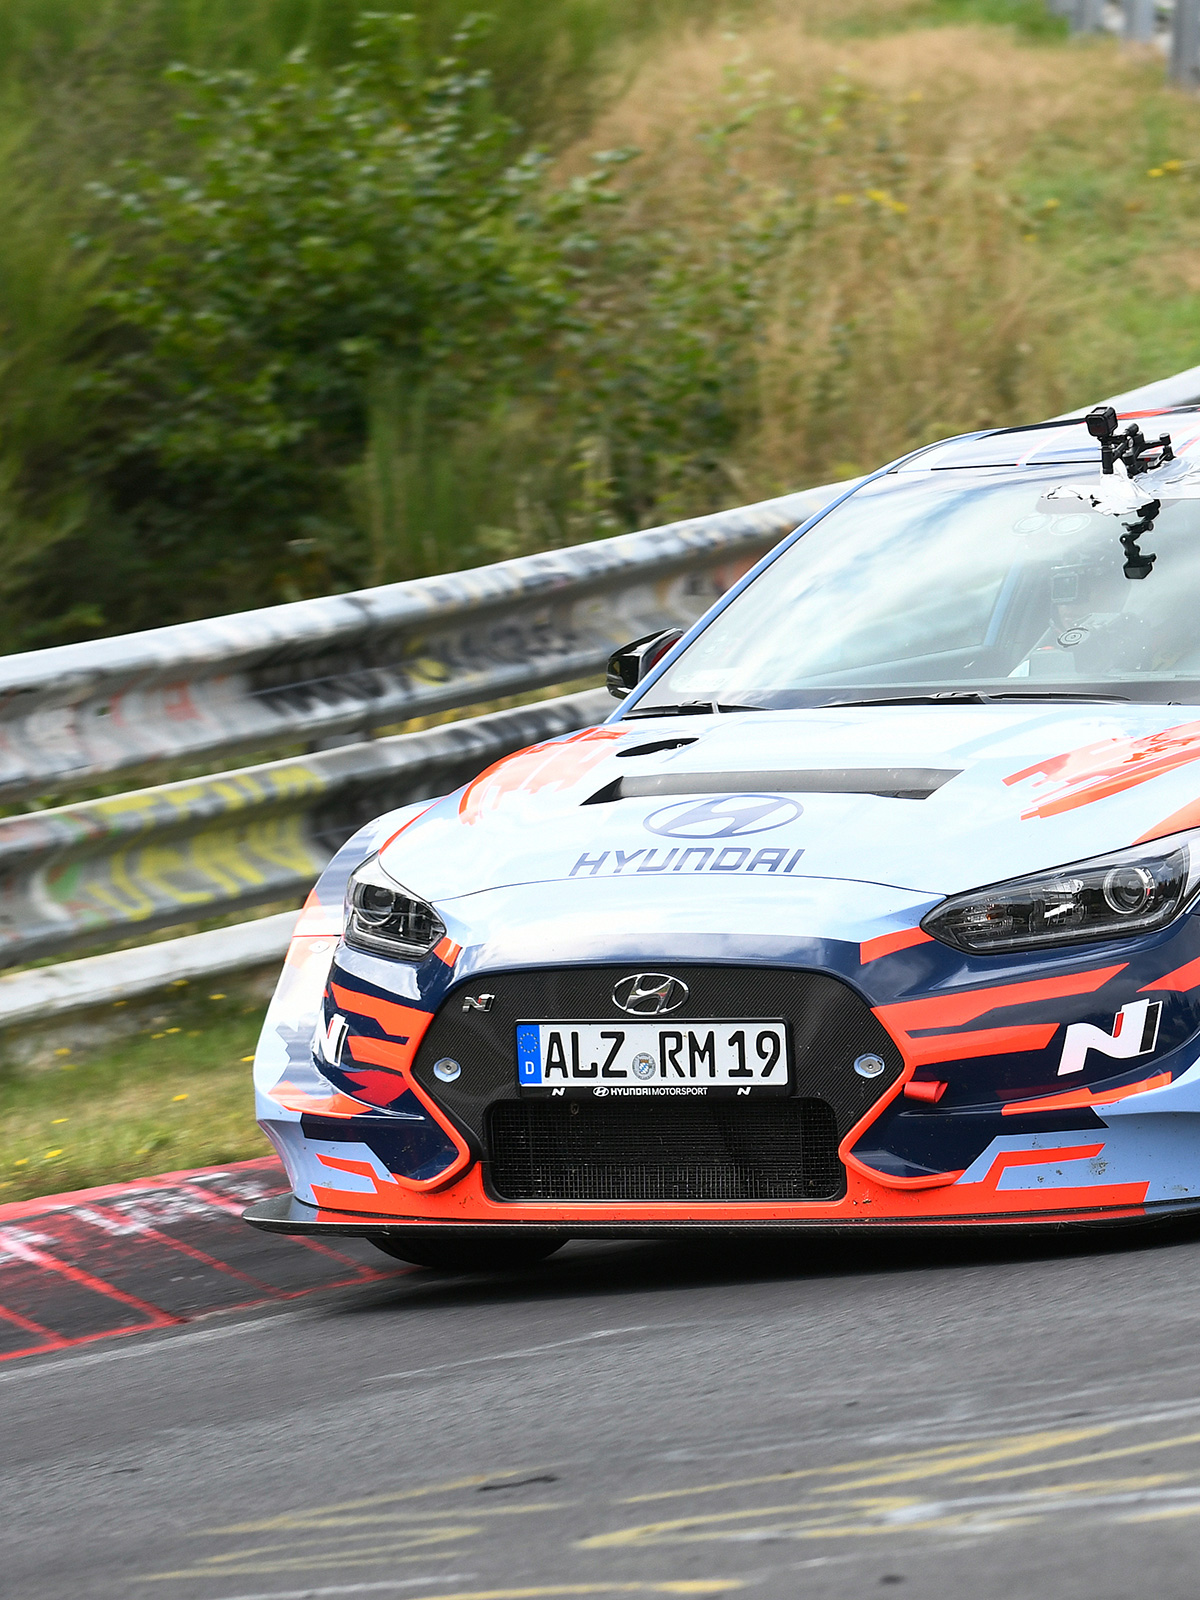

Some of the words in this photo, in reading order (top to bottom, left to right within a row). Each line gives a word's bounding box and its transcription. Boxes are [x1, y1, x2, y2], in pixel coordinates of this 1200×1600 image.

[568, 847, 806, 877] HYUNDAI
[544, 1030, 628, 1079] ALZ
[658, 1030, 717, 1078] RM
[727, 1029, 782, 1078] 19
